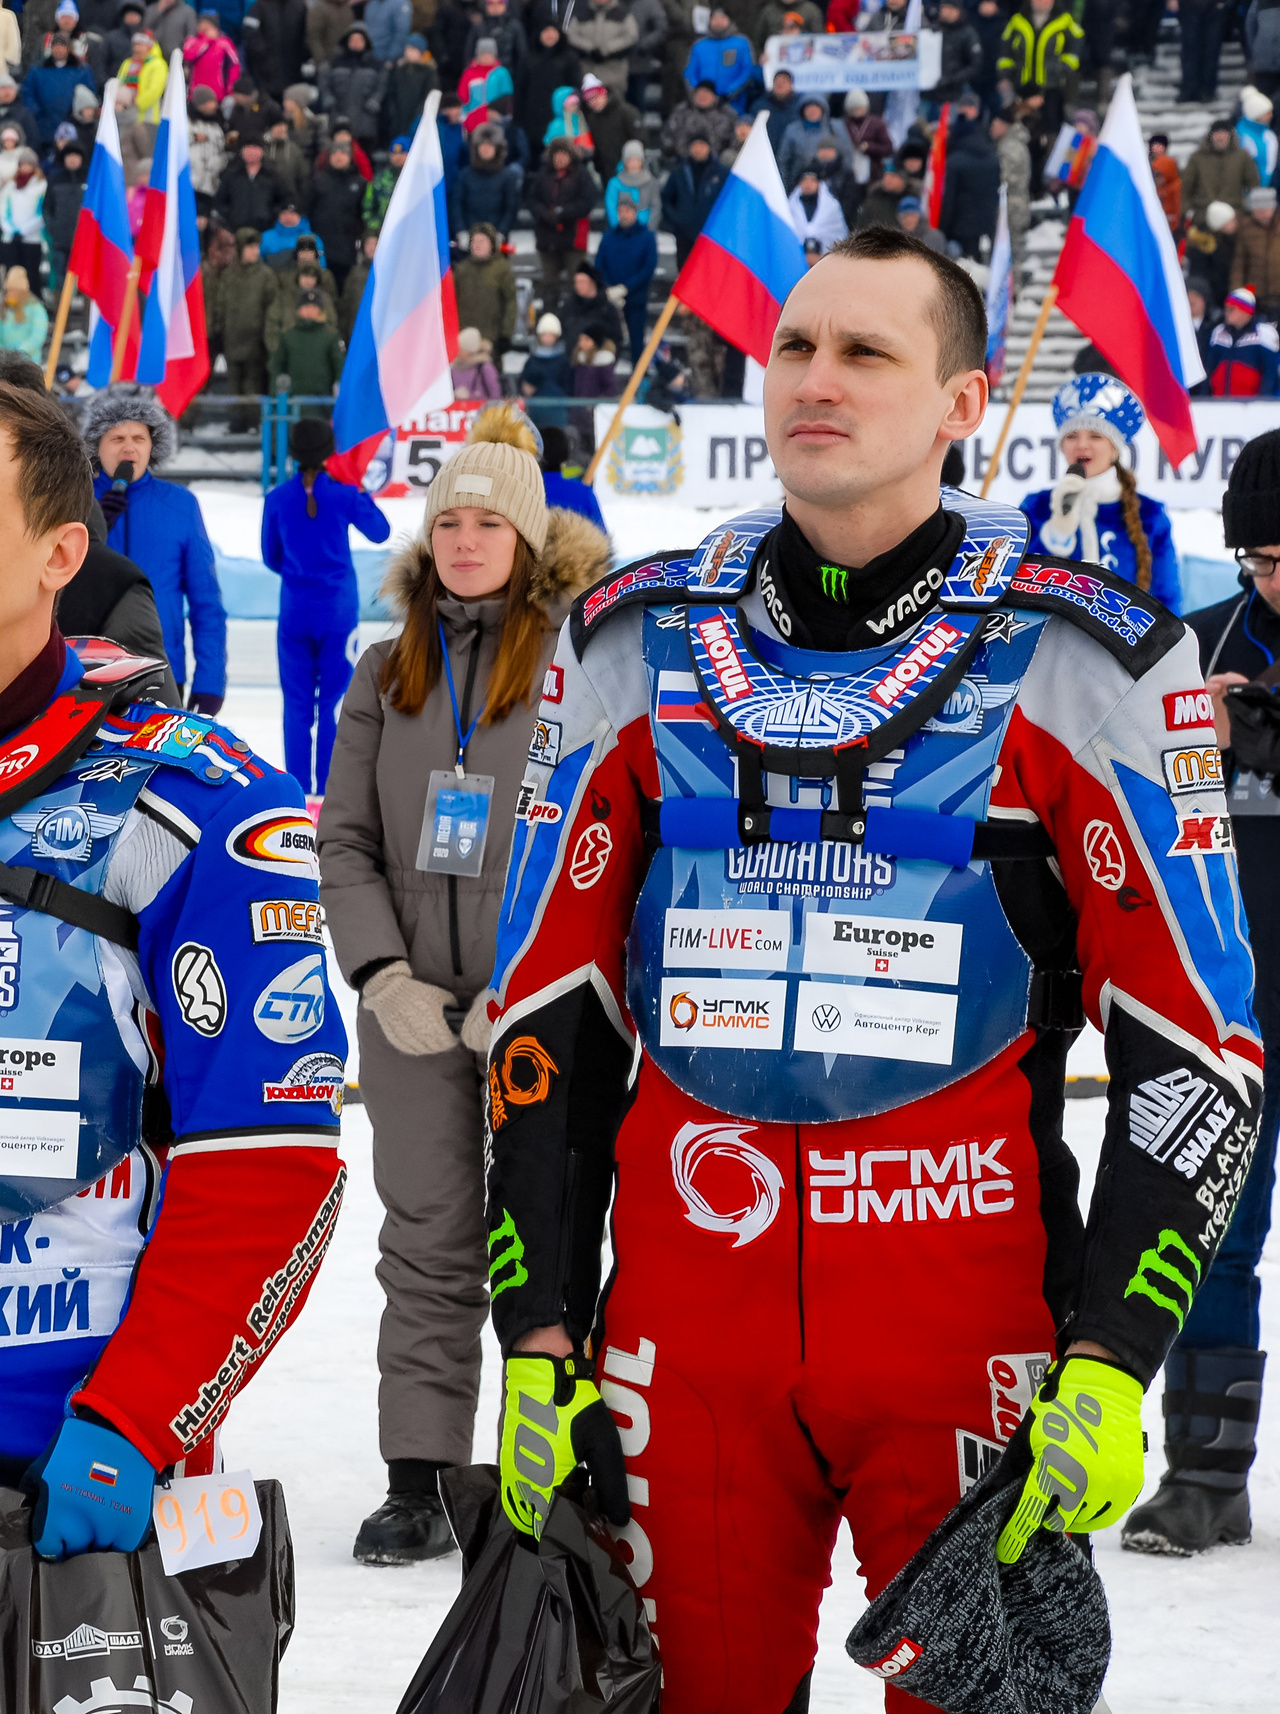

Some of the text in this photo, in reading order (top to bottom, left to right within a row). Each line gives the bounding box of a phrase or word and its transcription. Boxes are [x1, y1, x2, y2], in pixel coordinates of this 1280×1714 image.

[408, 440, 442, 487] 5
[974, 537, 1006, 596] MEFO
[866, 567, 944, 635] WACO
[1011, 580, 1138, 646] ww.sasse-bad.de
[699, 620, 751, 699] MOTUL
[874, 628, 958, 706] MOTUL
[942, 691, 973, 714] IM
[45, 817, 83, 842] FIM
[832, 920, 935, 953] Europe
[866, 947, 899, 959] Suisse
[702, 1000, 770, 1015] УГМК
[702, 1015, 770, 1029] UMMC
[854, 1018, 940, 1037] Автоцентр Керг
[40, 1142, 65, 1153] Керг
[1174, 1095, 1236, 1179] SHAAZ
[809, 1137, 1013, 1187] УГМК
[1195, 1117, 1252, 1213] BLACK
[810, 1179, 1015, 1223] UMMC
[249, 1168, 347, 1336] Reischmann
[173, 1338, 250, 1439] Hubert
[109, 1500, 133, 1514] TEAM
[157, 1487, 251, 1554] 919
[35, 1642, 62, 1656] ОАО
[109, 1635, 140, 1646] ШААЗ
